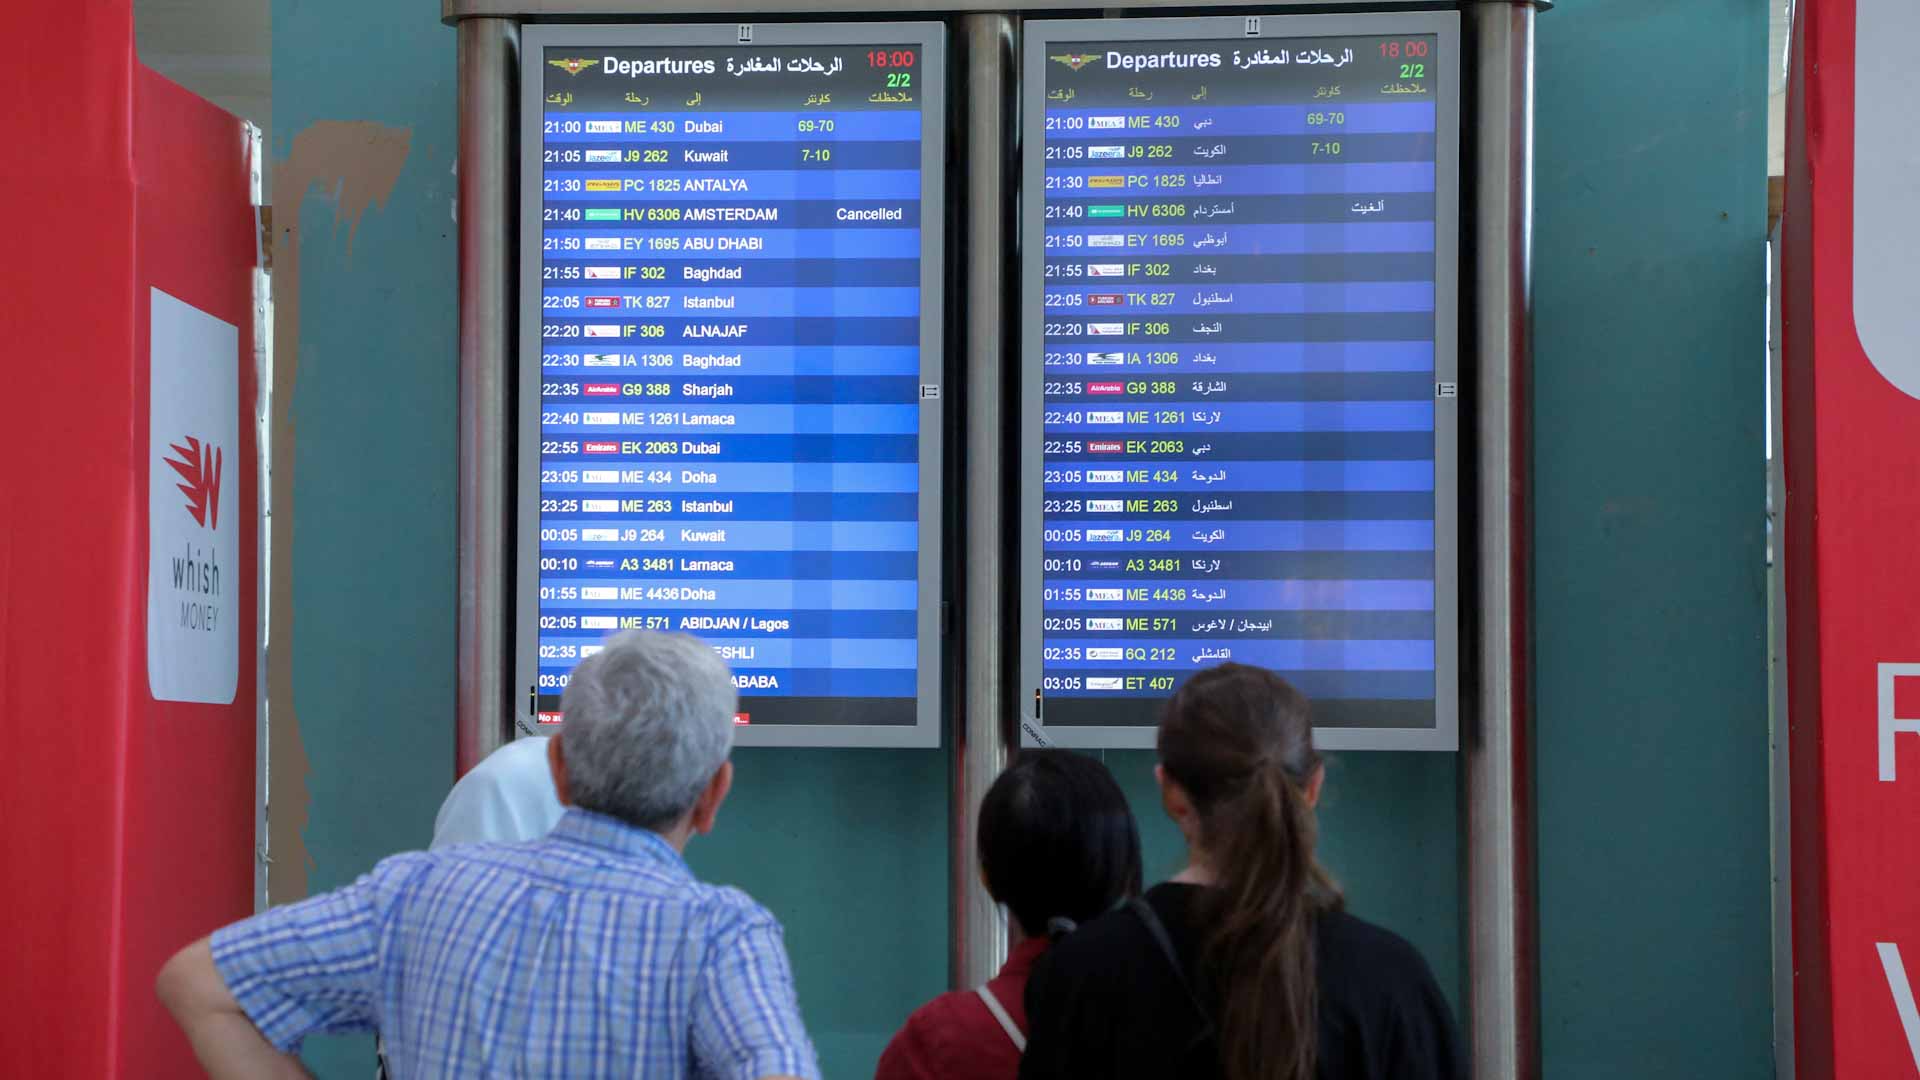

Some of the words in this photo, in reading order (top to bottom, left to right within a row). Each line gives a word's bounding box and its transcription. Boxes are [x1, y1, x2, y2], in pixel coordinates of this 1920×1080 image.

[868, 51, 914, 67] 18:00
[1107, 52, 1221, 72] Departures
[1234, 50, 1289, 69] المغادرة
[1296, 48, 1353, 67] الرحلات
[603, 57, 715, 77] Departures
[726, 57, 781, 76] المغادرة
[787, 57, 842, 75] الرحلات
[1400, 64, 1424, 78] 2/2
[887, 73, 911, 87] 2/2
[1048, 88, 1075, 101] الوقت
[1128, 87, 1153, 100] رحلة
[1314, 85, 1341, 98] كاونتر
[1381, 83, 1427, 94] ملاحظات
[545, 93, 573, 106] الوقت
[625, 92, 649, 106] رحلة
[804, 94, 831, 106] كاونتر
[868, 92, 912, 103] ملاحظات
[1046, 117, 1083, 129] 21:00
[1129, 116, 1150, 128] ME
[1155, 116, 1179, 127] 430
[1307, 113, 1344, 125] 69-70
[544, 121, 581, 133] 21:00
[625, 121, 646, 133] ME
[650, 121, 674, 132] 430
[685, 121, 722, 132] Dubai
[798, 120, 834, 132] 69-70
[1046, 146, 1083, 158] 21:05
[1128, 146, 1143, 157] J9
[1148, 146, 1172, 157] 262
[1311, 143, 1340, 154] 7-10
[544, 150, 580, 162] 21:05
[624, 150, 639, 162] J9
[644, 150, 668, 162] 262
[685, 150, 728, 162] Kuwait
[802, 150, 831, 161] 7-10
[543, 179, 580, 191] 21:30
[624, 179, 644, 191] PC
[649, 179, 680, 191] 1825
[684, 179, 748, 191] ANTALYA
[1046, 176, 1083, 188] 21:30
[1128, 176, 1148, 187] PC
[1154, 175, 1185, 186] 1825
[543, 208, 580, 220] 21:40
[624, 209, 644, 220] HV
[648, 209, 680, 220] 6306
[684, 208, 777, 220] AMSTERDAM
[836, 207, 902, 220] Cancelled
[1046, 205, 1083, 218] 21:40
[1128, 205, 1148, 216] HV
[1152, 205, 1185, 216] 6306
[543, 237, 580, 250] 21:50
[624, 238, 643, 249] EY
[648, 238, 679, 249] 1695
[683, 238, 714, 249] ABU
[718, 238, 762, 249] DHABI
[1046, 235, 1083, 247] 21:50
[1128, 235, 1147, 246] EY
[1153, 234, 1184, 246] 1695
[543, 266, 580, 279] 21:55
[624, 267, 636, 278] IF
[641, 267, 664, 279] 302
[684, 267, 741, 281] Baghdad
[542, 296, 579, 308] 22:05
[623, 296, 642, 308] TK
[647, 296, 670, 308] 827
[684, 296, 734, 308] Istanbul
[542, 325, 579, 337] 22:20
[624, 325, 636, 337] IF
[641, 325, 664, 337] 306
[683, 325, 747, 337] ALNAJAF
[542, 354, 579, 366] 22:30
[624, 355, 636, 366] IA
[642, 354, 673, 366] 1306
[683, 354, 741, 369] Baghdad
[542, 383, 579, 395] 22:35
[623, 384, 642, 395] G9
[646, 384, 670, 395] 388
[683, 384, 733, 398] Sharjah
[541, 412, 578, 424] 22:40
[623, 413, 644, 424] ME
[649, 413, 678, 424] 1261
[541, 441, 578, 454] 22:55
[622, 442, 641, 454] EK
[645, 442, 678, 454] 2063
[682, 442, 720, 454] Dubai
[541, 471, 578, 483] 23:05
[622, 471, 643, 483] ME
[648, 471, 672, 483] 434
[682, 471, 716, 483] Doha
[541, 500, 578, 512] 23:25
[622, 500, 643, 512] ME
[647, 500, 671, 512] 263
[682, 500, 732, 512] Istanbul
[540, 529, 577, 541] 00:05
[621, 529, 637, 541] J9
[640, 529, 664, 541] 264
[681, 530, 725, 541] Kuwait
[172, 543, 220, 595] whish
[540, 558, 577, 570] 00:10
[620, 559, 639, 570] A3
[643, 559, 673, 570] 3481
[540, 587, 577, 599] 01:55
[621, 588, 642, 600] ME
[647, 588, 679, 600] 4436
[681, 588, 715, 600] Doha
[180, 602, 219, 632] MONEY
[540, 616, 577, 629] 02:05
[620, 617, 642, 629] ME
[647, 617, 670, 629] 571
[680, 617, 739, 629] ABIDJAN
[751, 618, 789, 632] Lagos
[539, 646, 576, 658] 02:35
